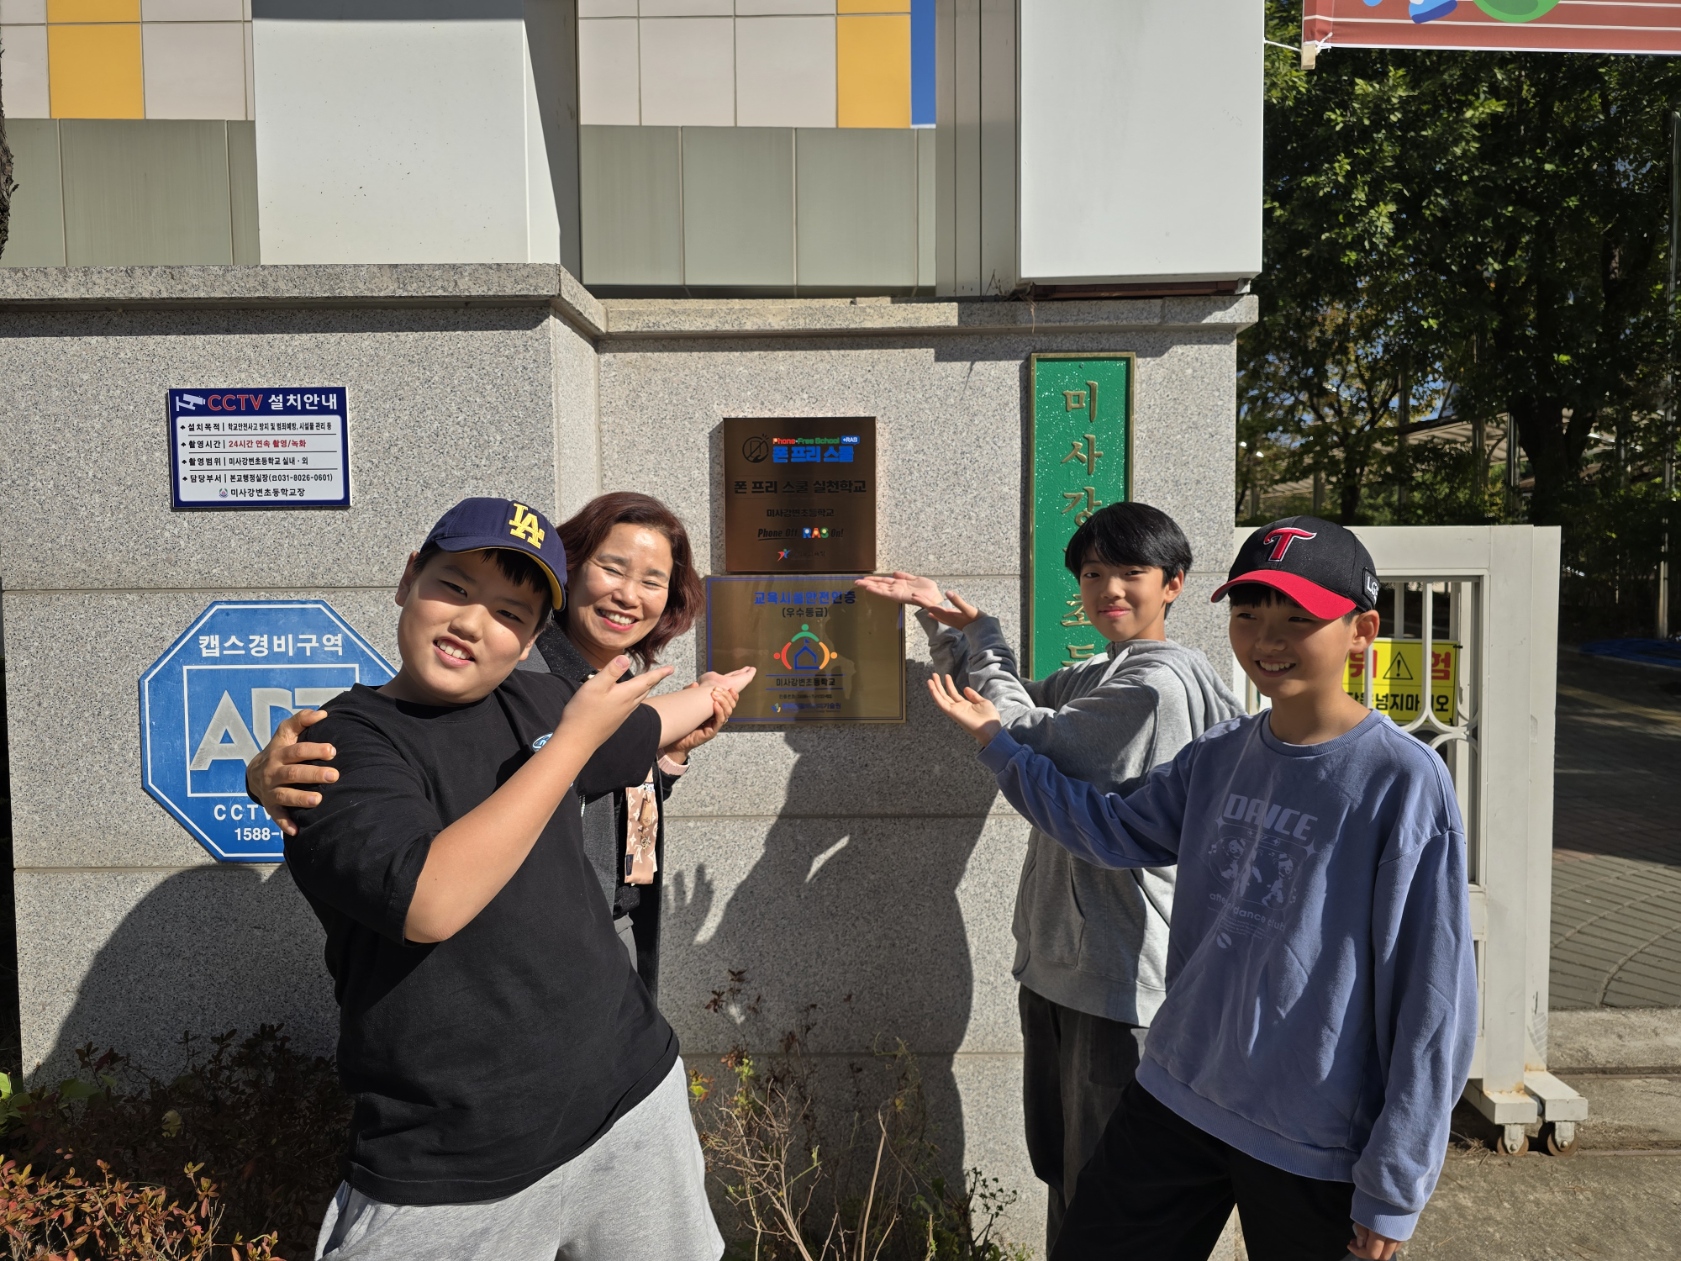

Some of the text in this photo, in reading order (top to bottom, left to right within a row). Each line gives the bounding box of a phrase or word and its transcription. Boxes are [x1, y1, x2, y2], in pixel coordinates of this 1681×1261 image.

[207, 393, 337, 411] CCTV 설치안내
[188, 423, 220, 432] 설치목적
[259, 422, 269, 431] 방지
[316, 422, 325, 431] 관리
[188, 440, 221, 449] 촬영시간
[228, 440, 253, 448] 24시간
[255, 440, 270, 448] 연속
[815, 437, 840, 445] School
[772, 445, 789, 463] 폰
[791, 445, 821, 463] 프리
[188, 457, 221, 466] 촬영범위
[228, 457, 281, 466] 미사강변초등학교
[282, 457, 296, 465] 실내
[190, 474, 221, 483] 담당부서
[230, 488, 305, 497] 미사강변초등학교장
[734, 479, 867, 494] 폰 프리 스쿨 실천학교
[766, 508, 835, 518] 미사강변초등학교
[508, 502, 546, 550] LA
[757, 528, 783, 538] Phone
[802, 527, 830, 539] RAS
[1263, 527, 1317, 562] T
[753, 590, 856, 605] 교육시설안전인증
[782, 607, 828, 618] (우수등급)
[198, 633, 344, 657] 캡스경비구역
[776, 677, 836, 687] 미사강변초등학교
[1222, 793, 1319, 841] DANCE
[234, 827, 284, 841] 1588-
